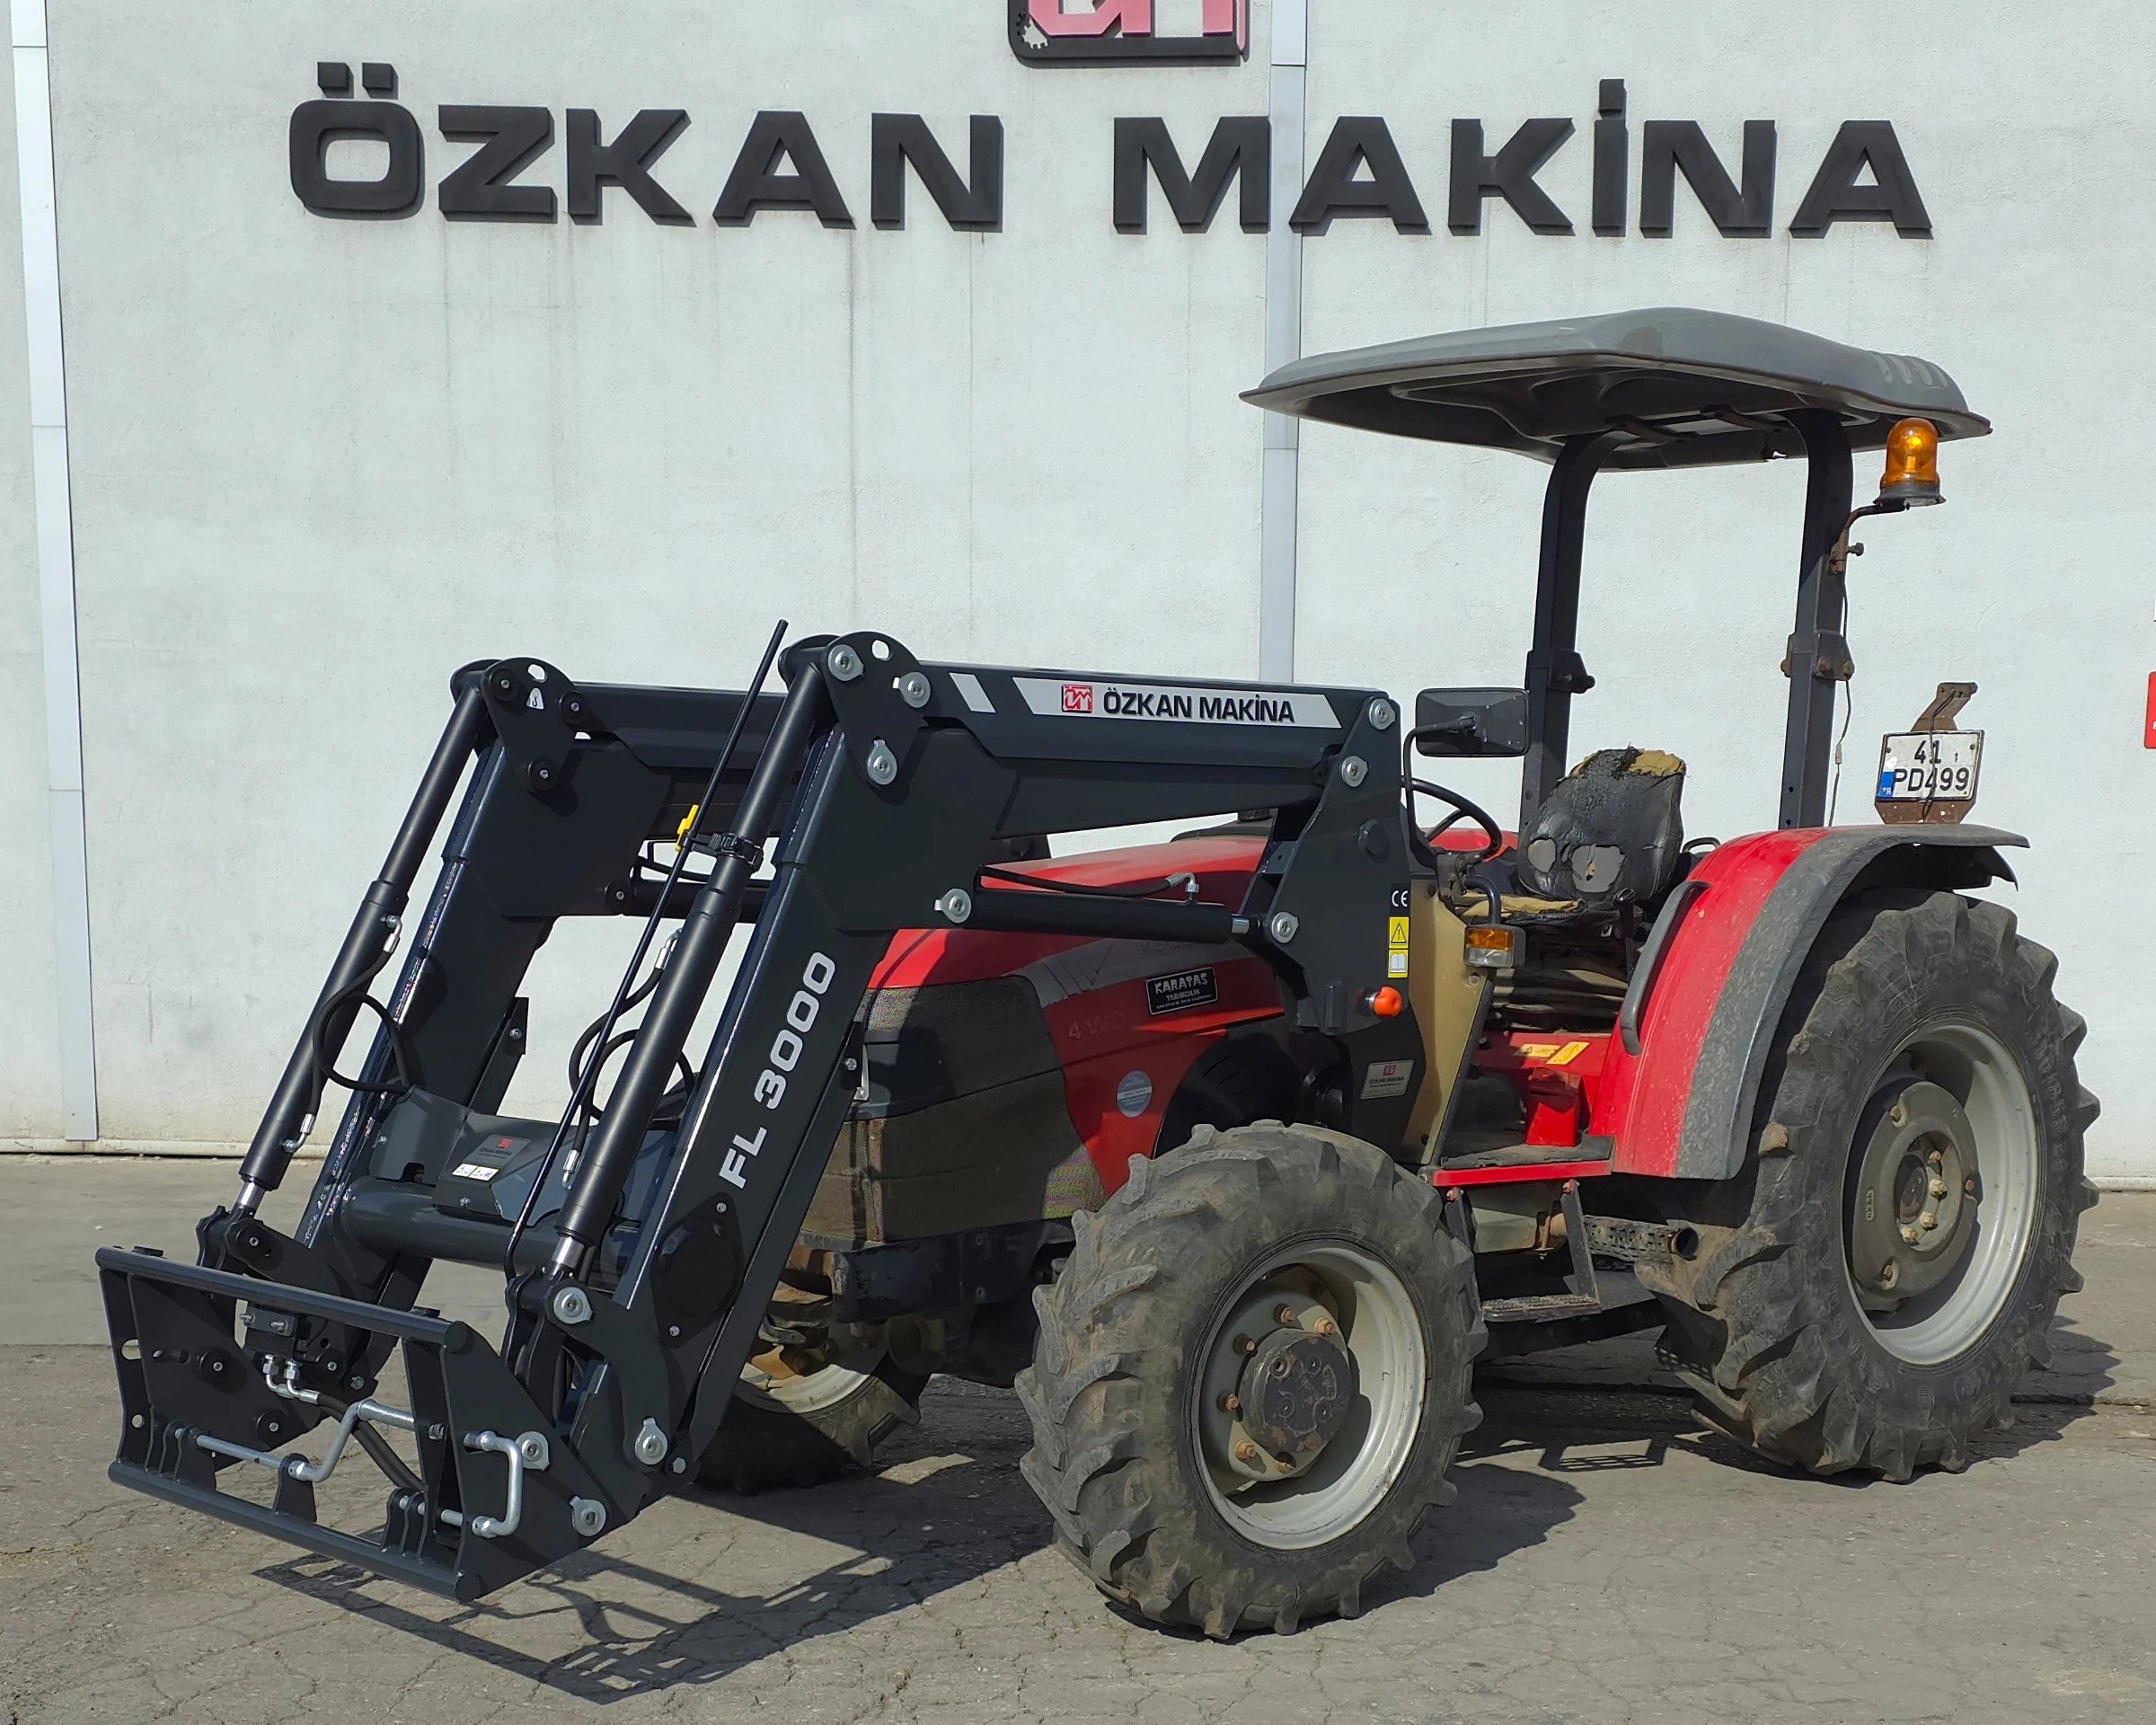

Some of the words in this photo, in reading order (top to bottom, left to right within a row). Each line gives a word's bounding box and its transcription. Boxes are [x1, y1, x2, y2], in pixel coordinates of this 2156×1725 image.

[289, 62, 1004, 233] ÖZKAN
[1113, 78, 1933, 238] MAKİNA
[1103, 686, 1193, 720] ÖZKAN
[1198, 694, 1295, 724] MAKİNA
[1913, 739, 1942, 764] 41
[1893, 766, 1970, 792] PD499
[719, 1126, 767, 1189] FL
[754, 951, 835, 1110] 3000
